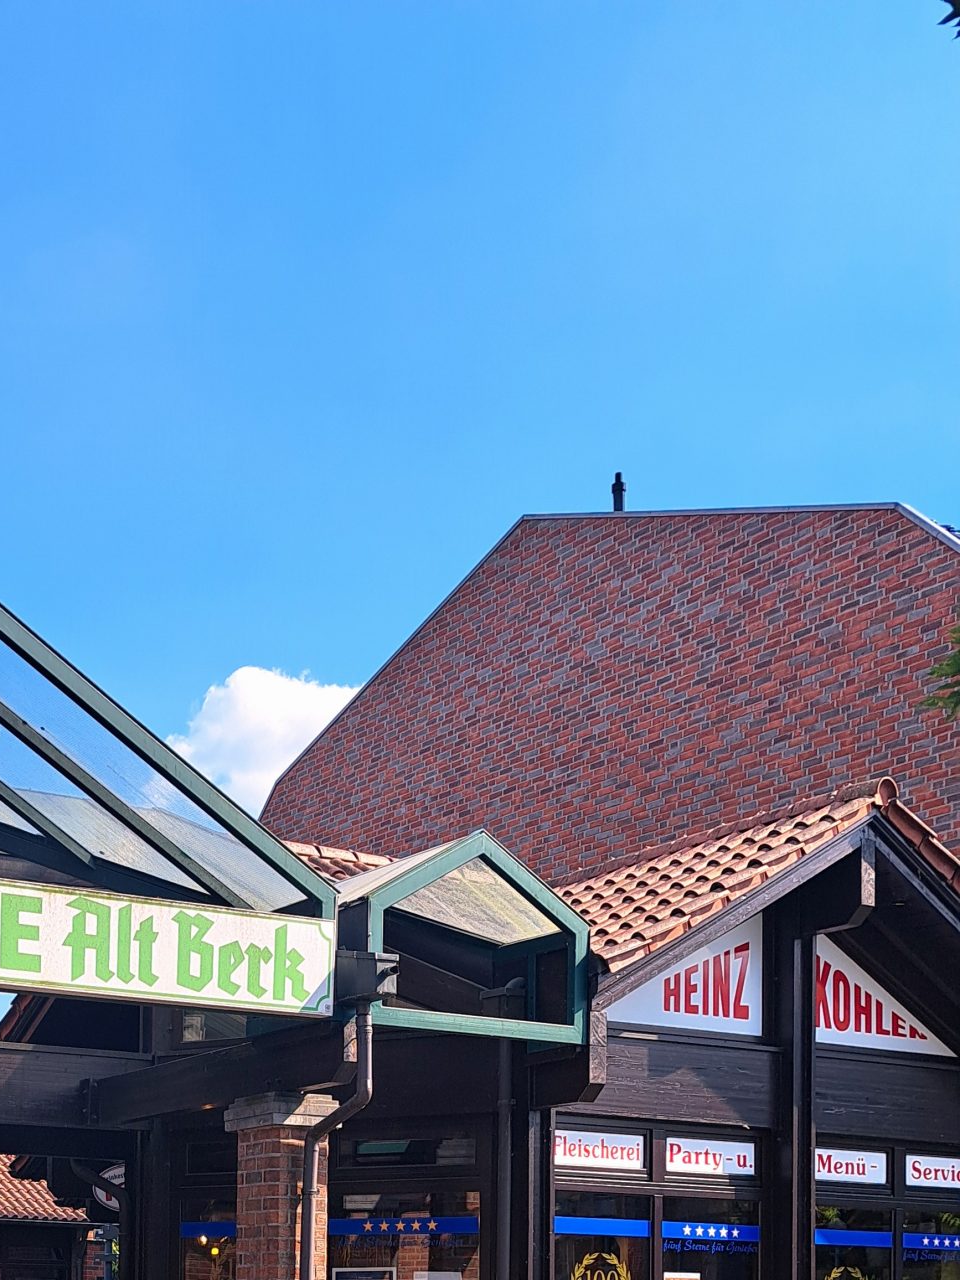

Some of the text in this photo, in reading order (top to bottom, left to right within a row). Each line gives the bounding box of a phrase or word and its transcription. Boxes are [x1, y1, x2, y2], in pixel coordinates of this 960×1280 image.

[63, 897, 159, 987] Alt
[171, 910, 311, 1003] Berk
[663, 941, 750, 1020] HEINZ
[553, 1134, 641, 1161] Fleischerei
